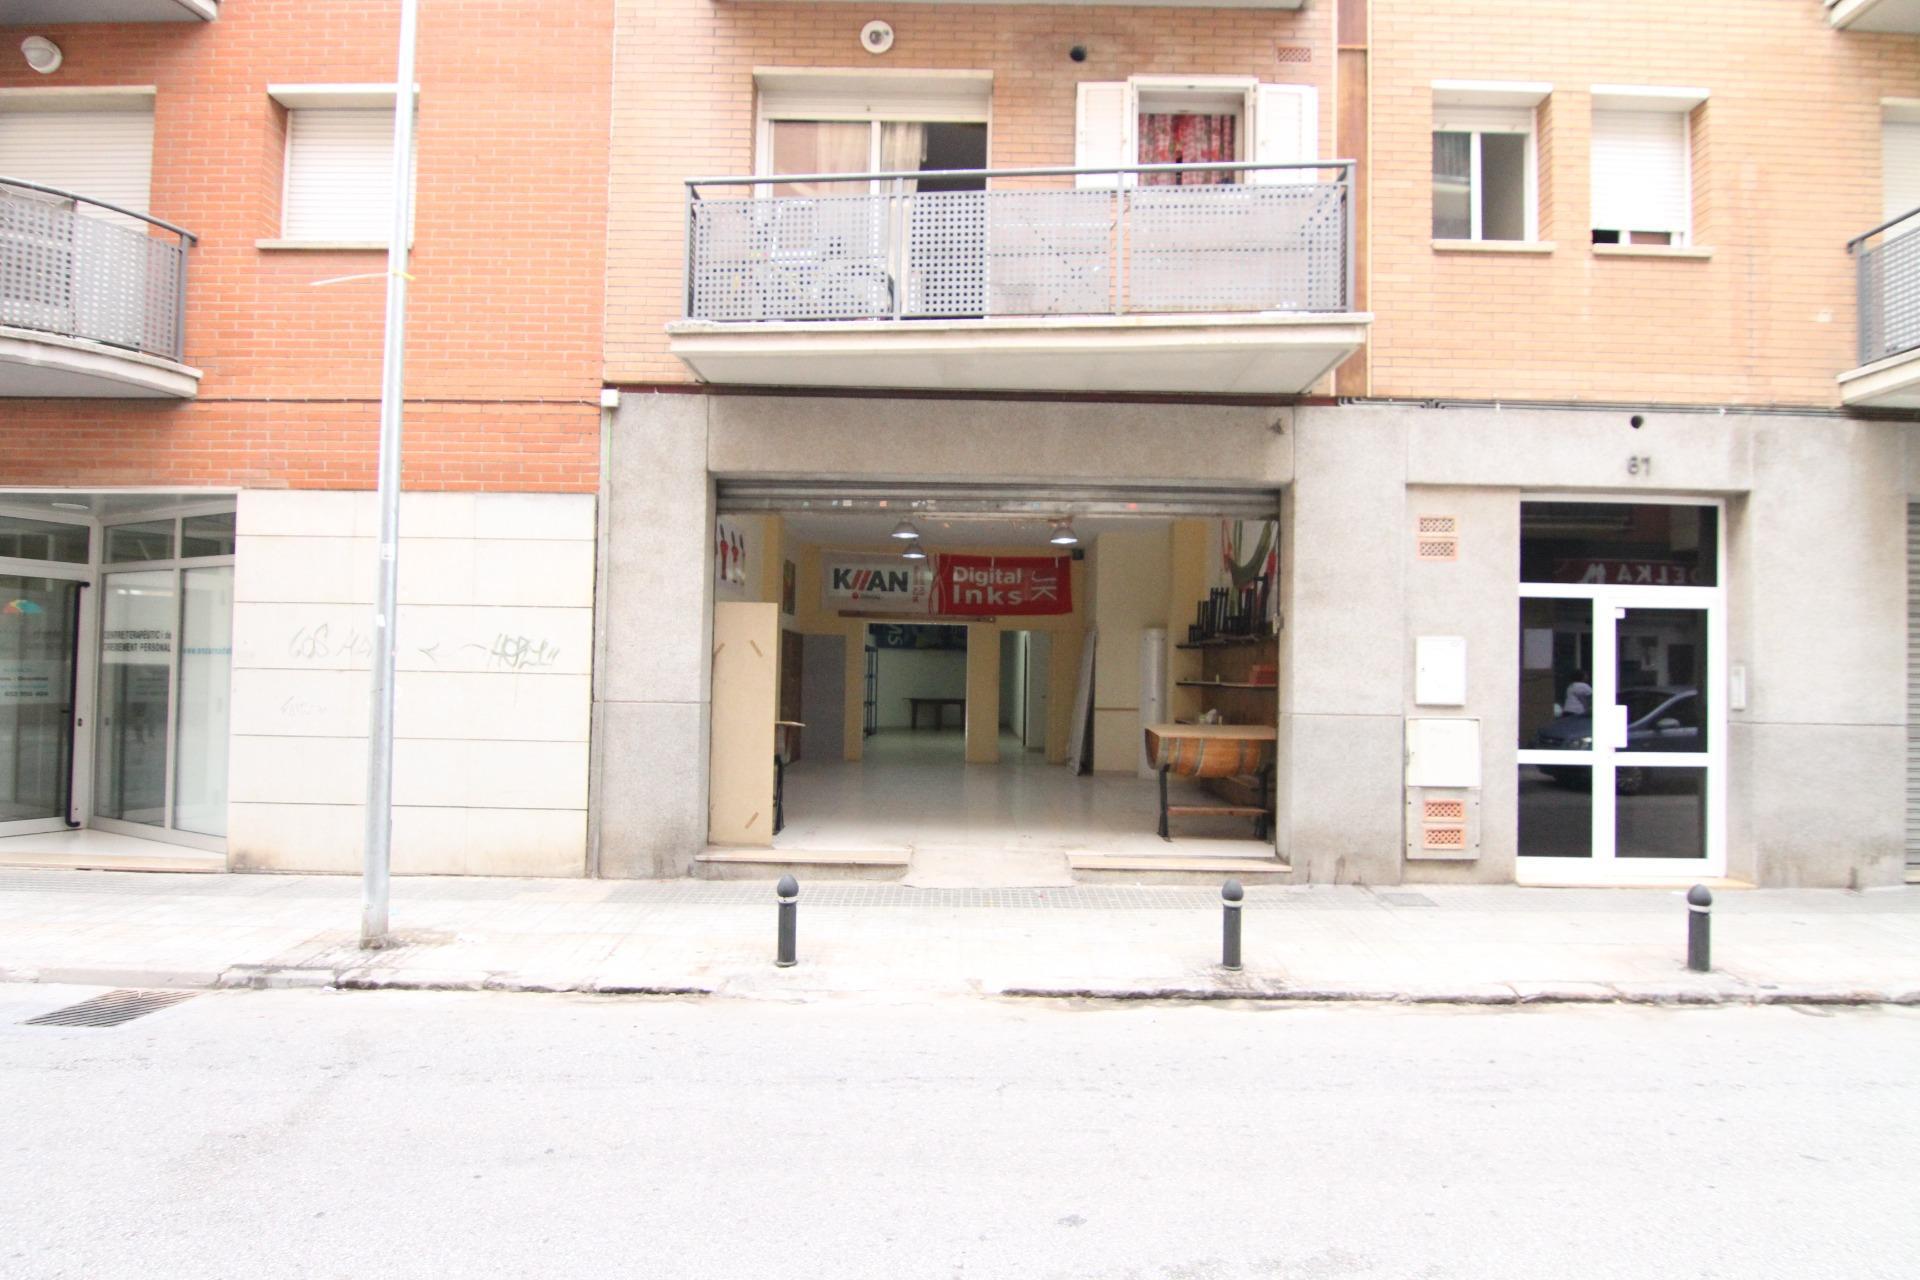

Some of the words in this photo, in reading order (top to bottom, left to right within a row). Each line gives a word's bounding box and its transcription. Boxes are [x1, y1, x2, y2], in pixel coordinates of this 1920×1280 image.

[953, 565, 1022, 587] Digital
[953, 584, 1024, 606] Inks
[140, 642, 171, 652] PERSONAL
